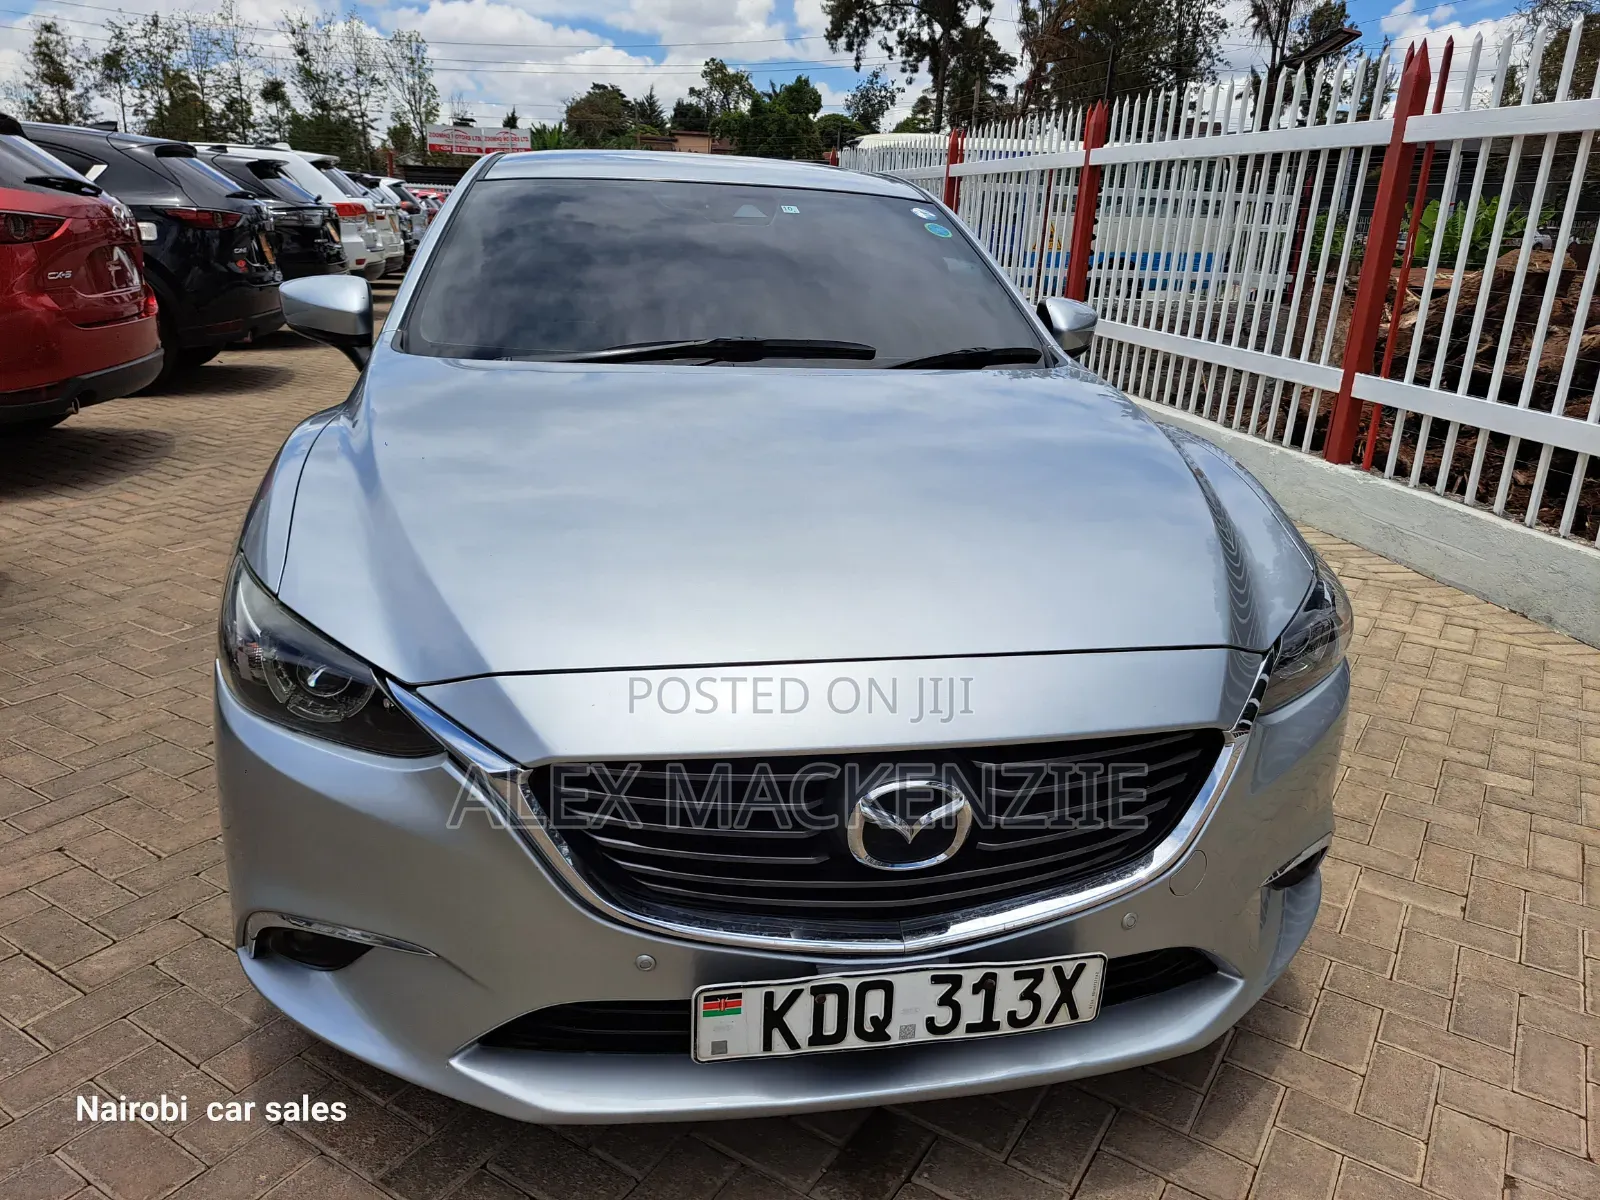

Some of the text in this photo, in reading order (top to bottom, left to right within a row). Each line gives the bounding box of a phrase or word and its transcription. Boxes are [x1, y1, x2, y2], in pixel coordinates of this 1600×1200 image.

[47, 270, 73, 280] CX-5
[762, 978, 896, 1052] KDQ
[925, 962, 1087, 1036] 313X
